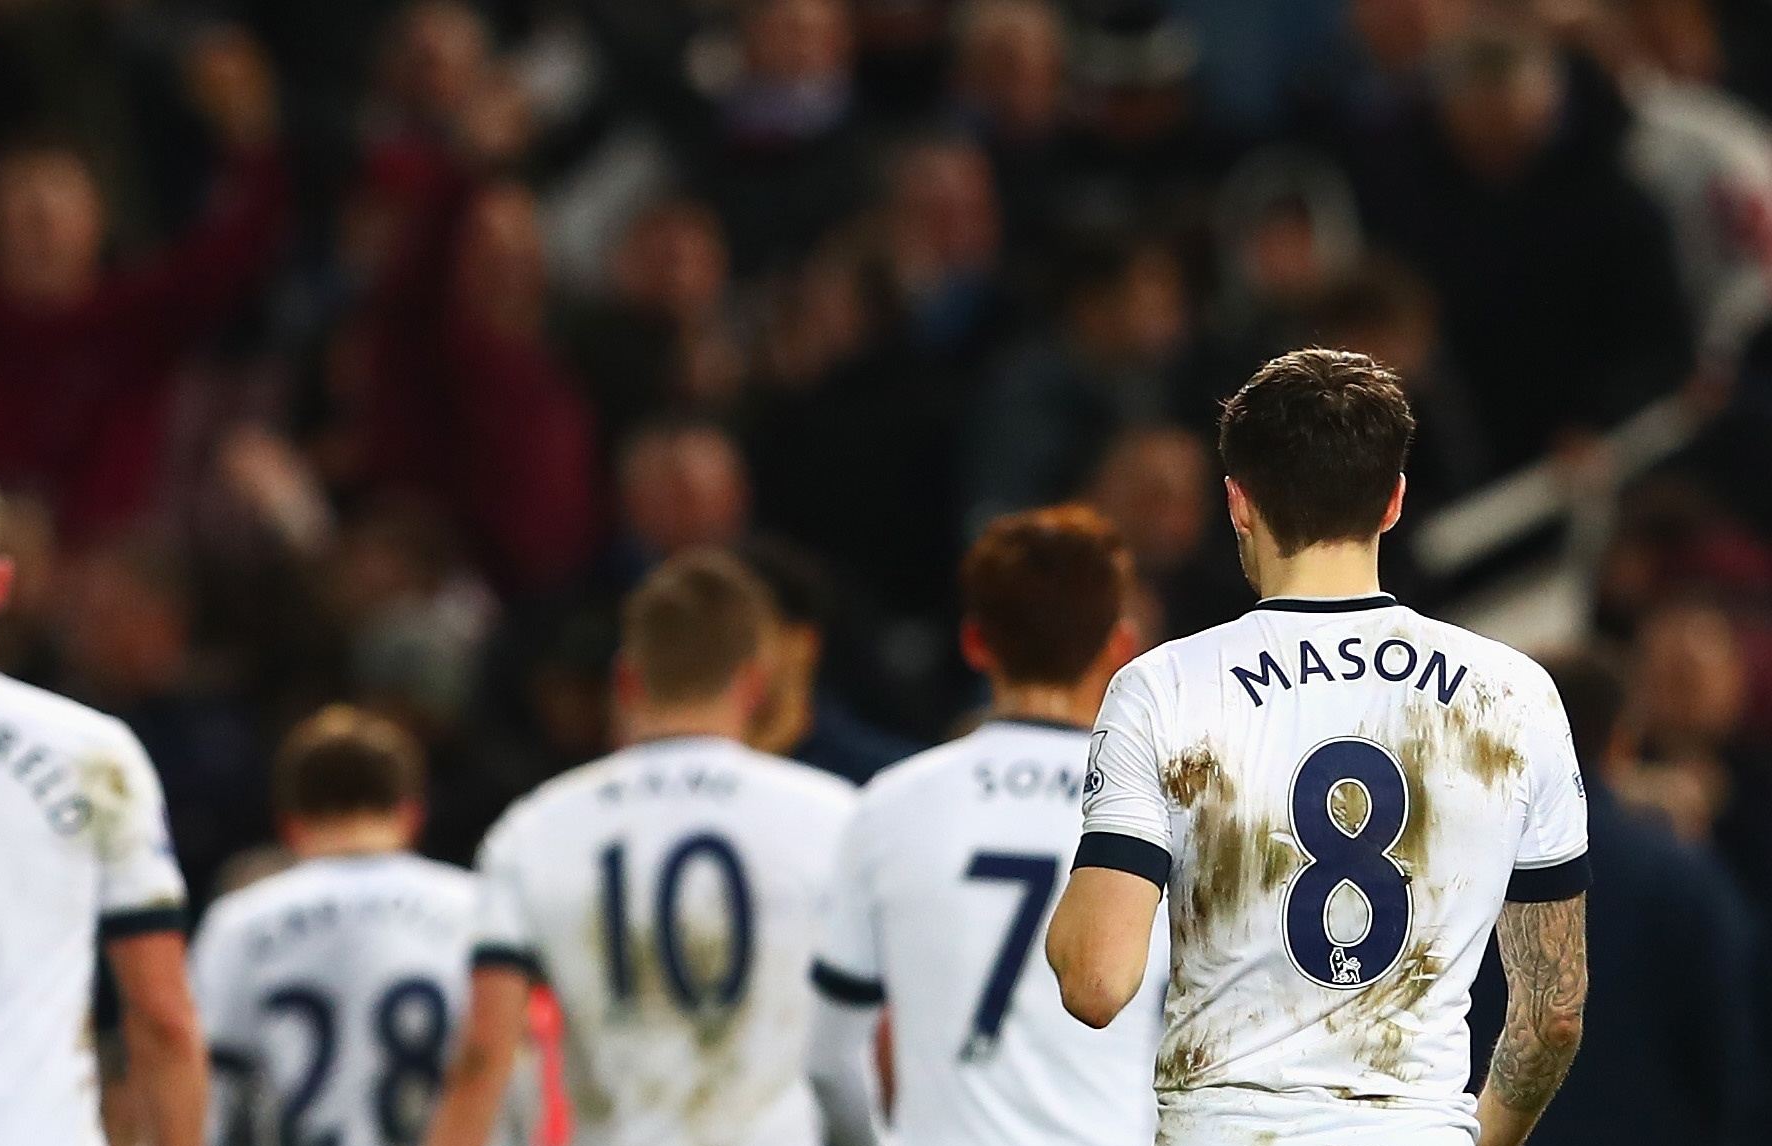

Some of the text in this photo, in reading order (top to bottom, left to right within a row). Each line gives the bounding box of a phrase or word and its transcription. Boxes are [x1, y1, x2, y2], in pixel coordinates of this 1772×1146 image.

[1229, 636, 1468, 707] MASON
[598, 830, 754, 1026] 10
[958, 850, 1059, 1062] 7
[1281, 735, 1413, 990] 8
